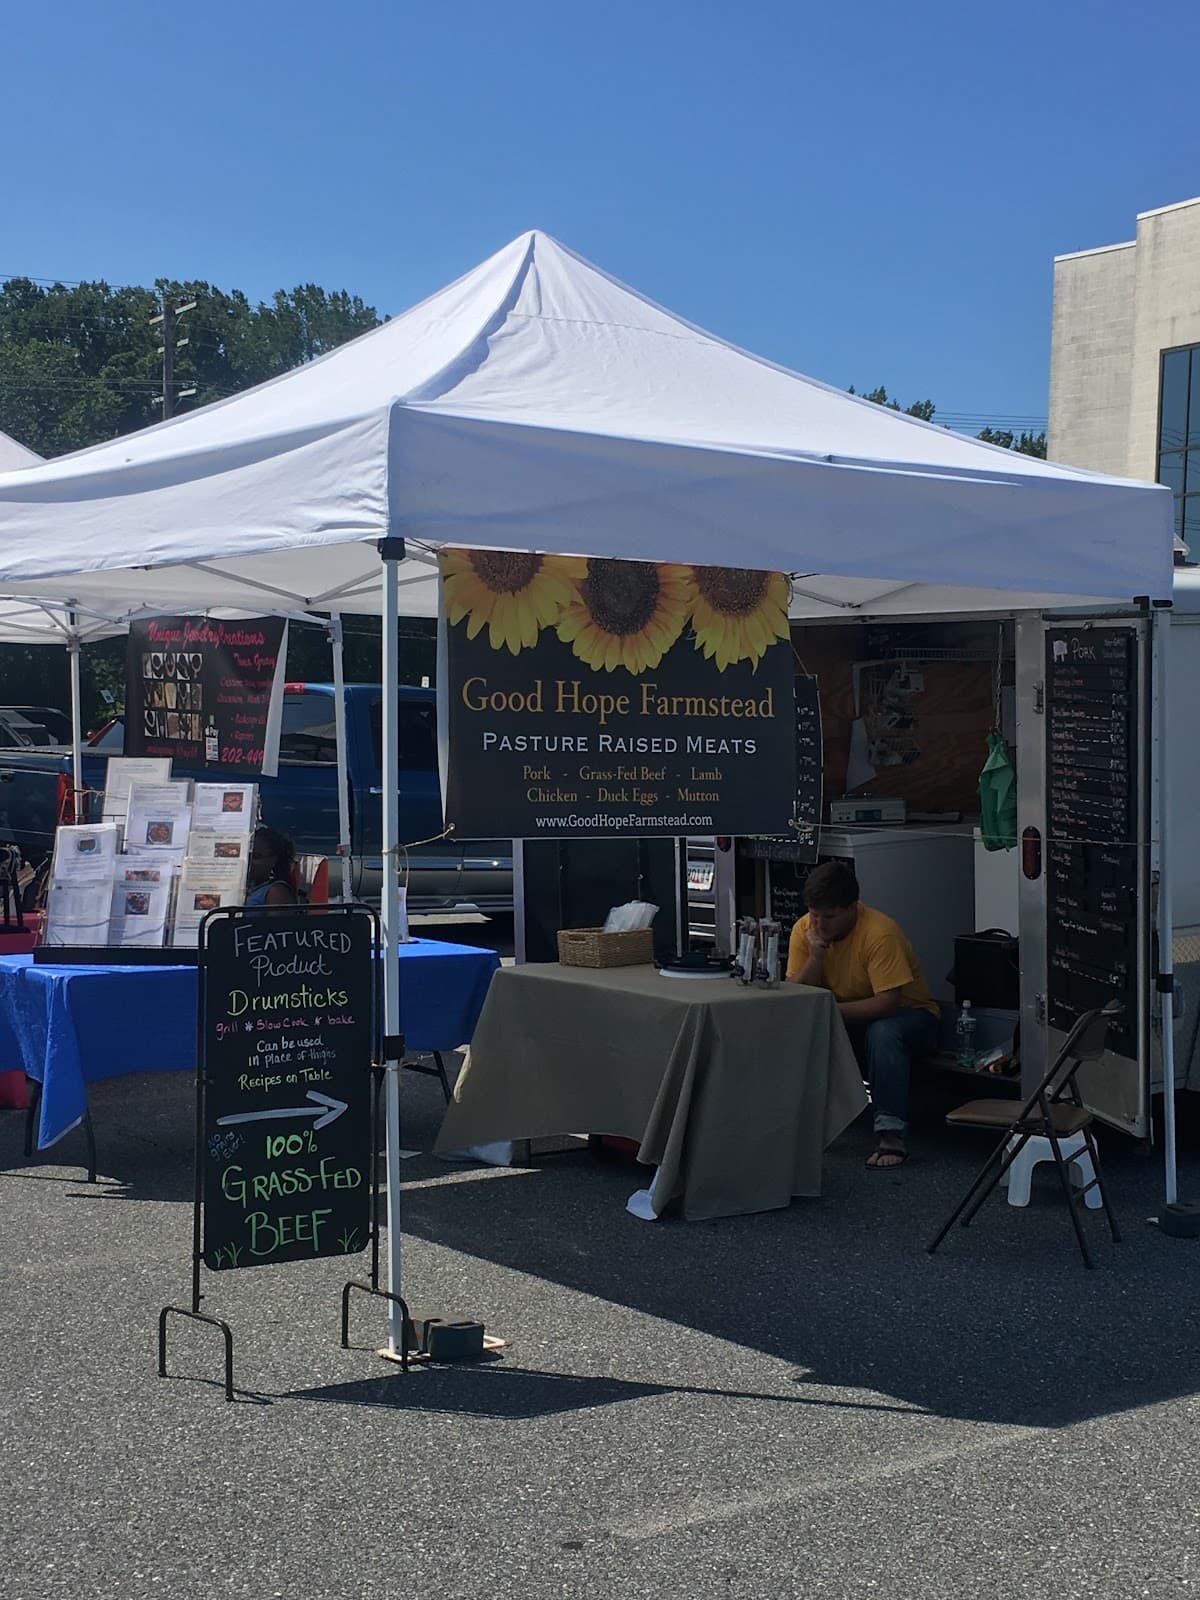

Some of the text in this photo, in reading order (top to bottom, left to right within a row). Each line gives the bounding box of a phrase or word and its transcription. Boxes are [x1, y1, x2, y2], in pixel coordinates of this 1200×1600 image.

[462, 676, 775, 724] Good Hope Farmstead
[482, 732, 757, 754] PASTURE RAISED MEATS
[523, 765, 722, 781] Pork Grass-Fed Beef Lamb
[527, 788, 720, 806] Chicken Duck Eggs Mutton
[536, 813, 713, 828] www.GoodHopeFarmstead.com
[234, 924, 351, 957] FEATURED
[250, 954, 333, 987] Product
[227, 984, 349, 1016] Drumsticks
[216, 1022, 238, 1040] grill
[328, 1014, 355, 1026] bake
[256, 1035, 324, 1053] Can be used
[265, 1051, 293, 1068] place
[286, 1074, 298, 1084] on
[299, 1067, 333, 1083] Table
[266, 1130, 318, 1159] 100%
[222, 1156, 362, 1208] GRASS-FED
[244, 1209, 332, 1256] BEEF
